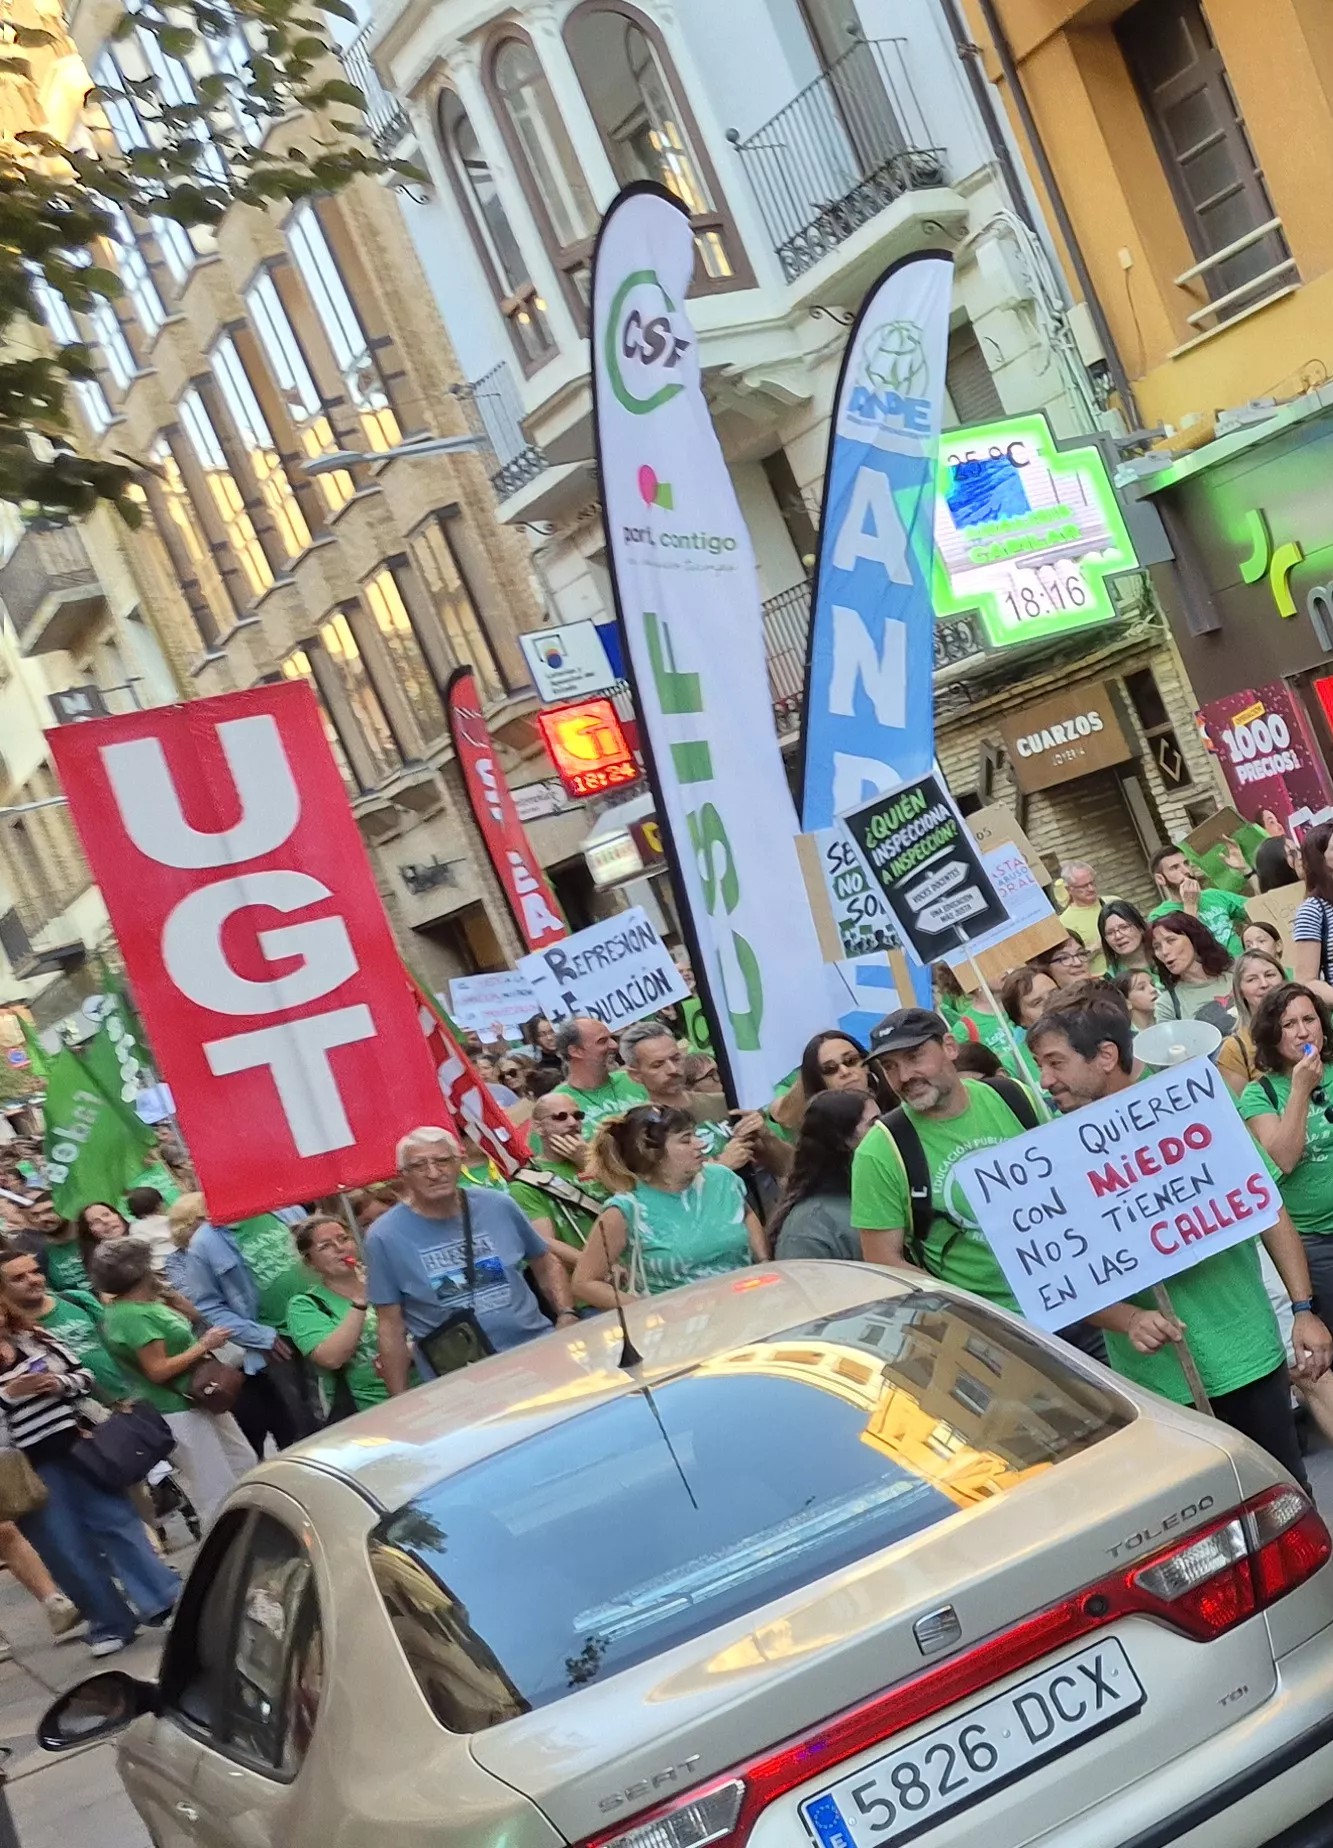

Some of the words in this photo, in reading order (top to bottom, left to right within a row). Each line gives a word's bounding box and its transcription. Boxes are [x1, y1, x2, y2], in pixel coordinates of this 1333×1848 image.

[1006, 576, 1085, 622] 18:16
[1016, 711, 1104, 757] CUARZOS
[1222, 713, 1290, 763] 1000
[865, 788, 928, 849] ¿QUIÉN
[871, 803, 951, 867] INSPECCIONA
[836, 872, 863, 897] NO
[880, 867, 894, 886] A
[99, 713, 378, 1159] UGT
[543, 915, 658, 985] REPRESIÓN
[974, 1146, 1054, 1203] NOS
[1079, 1068, 1215, 1155] QUIEREN
[1012, 1186, 1068, 1233] CON
[1086, 1123, 1213, 1198] MIEDO
[1016, 1228, 1089, 1276] NOS
[1102, 1162, 1215, 1233] TIENEN
[1038, 1273, 1078, 1313] EN
[1088, 1247, 1139, 1288] LAS
[1150, 1173, 1271, 1256] CALLES
[1105, 1494, 1216, 1560] TOLEDO
[1216, 1683, 1250, 1706] TDI
[850, 1724, 999, 1836] 5826
[1012, 1653, 1123, 1745] DCX
[597, 1753, 701, 1814] SEAT
